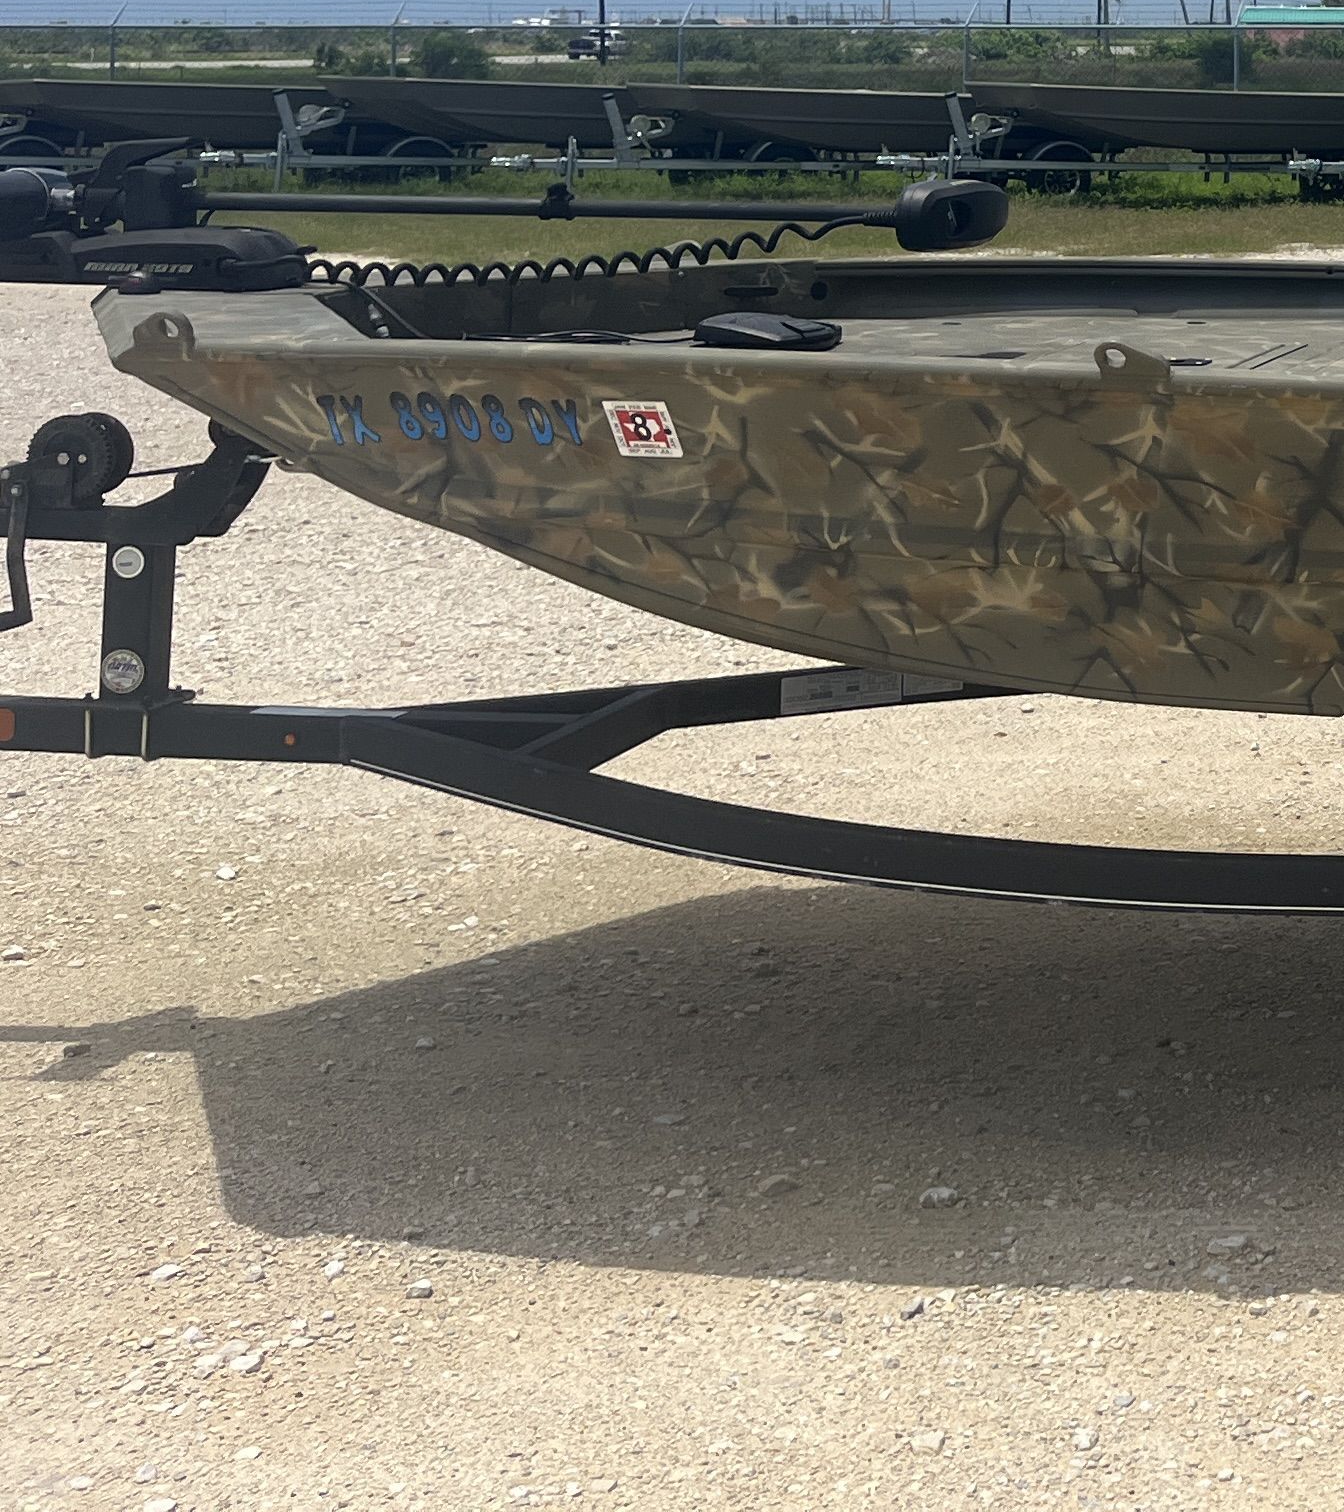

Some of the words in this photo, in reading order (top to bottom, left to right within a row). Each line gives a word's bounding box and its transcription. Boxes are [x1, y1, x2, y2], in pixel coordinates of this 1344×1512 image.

[316, 394, 380, 445] TX
[390, 391, 514, 443] 8908
[518, 397, 582, 446] DY
[631, 413, 651, 441] 8
